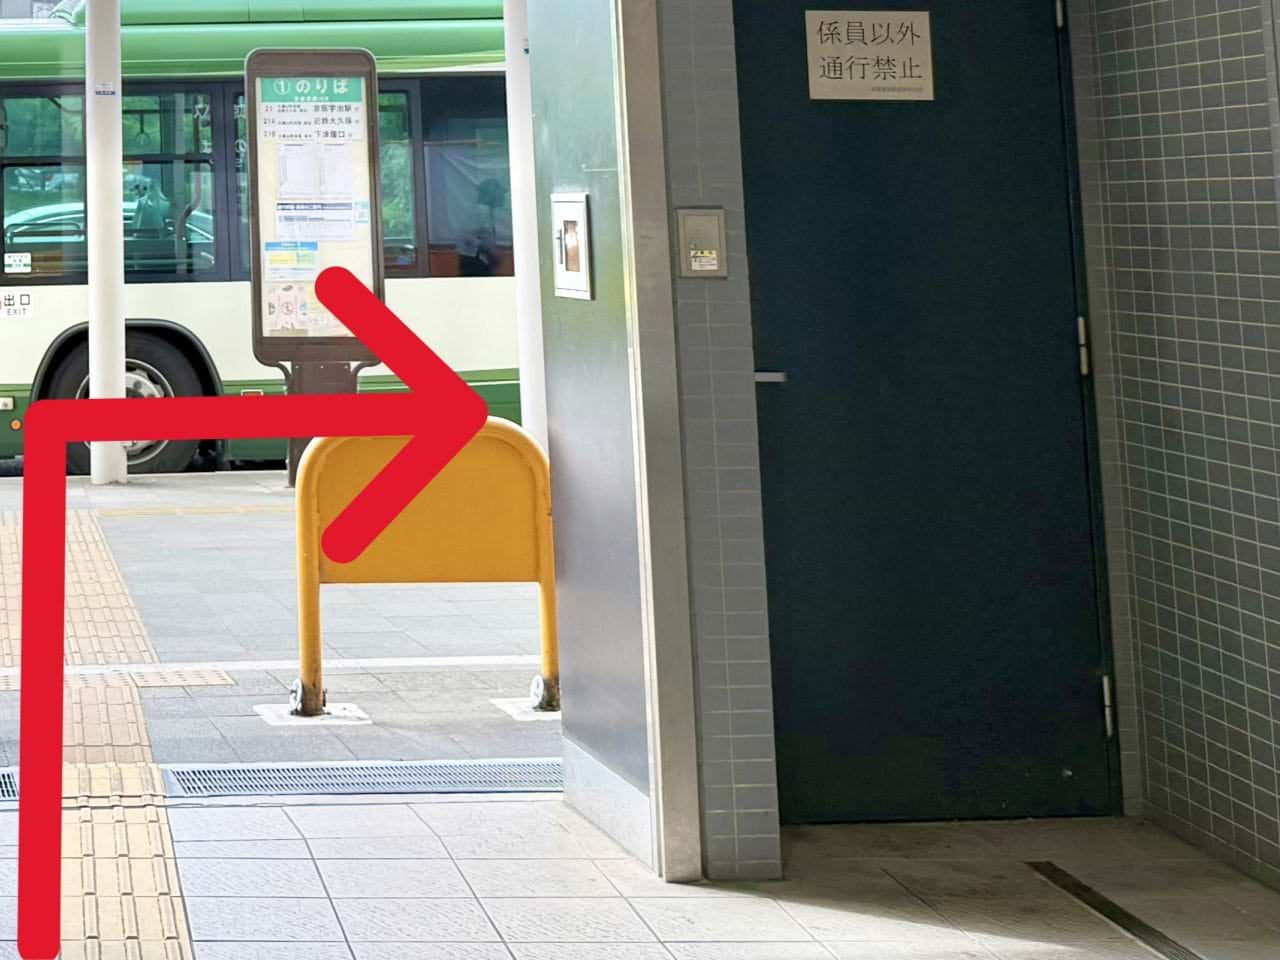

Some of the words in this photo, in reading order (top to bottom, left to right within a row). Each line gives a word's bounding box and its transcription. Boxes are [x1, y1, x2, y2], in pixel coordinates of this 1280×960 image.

[817, 20, 920, 46] 係員以外
[820, 55, 922, 80] 通行禁止
[3, 293, 31, 307] 出口
[7, 308, 28, 316] EXIT
